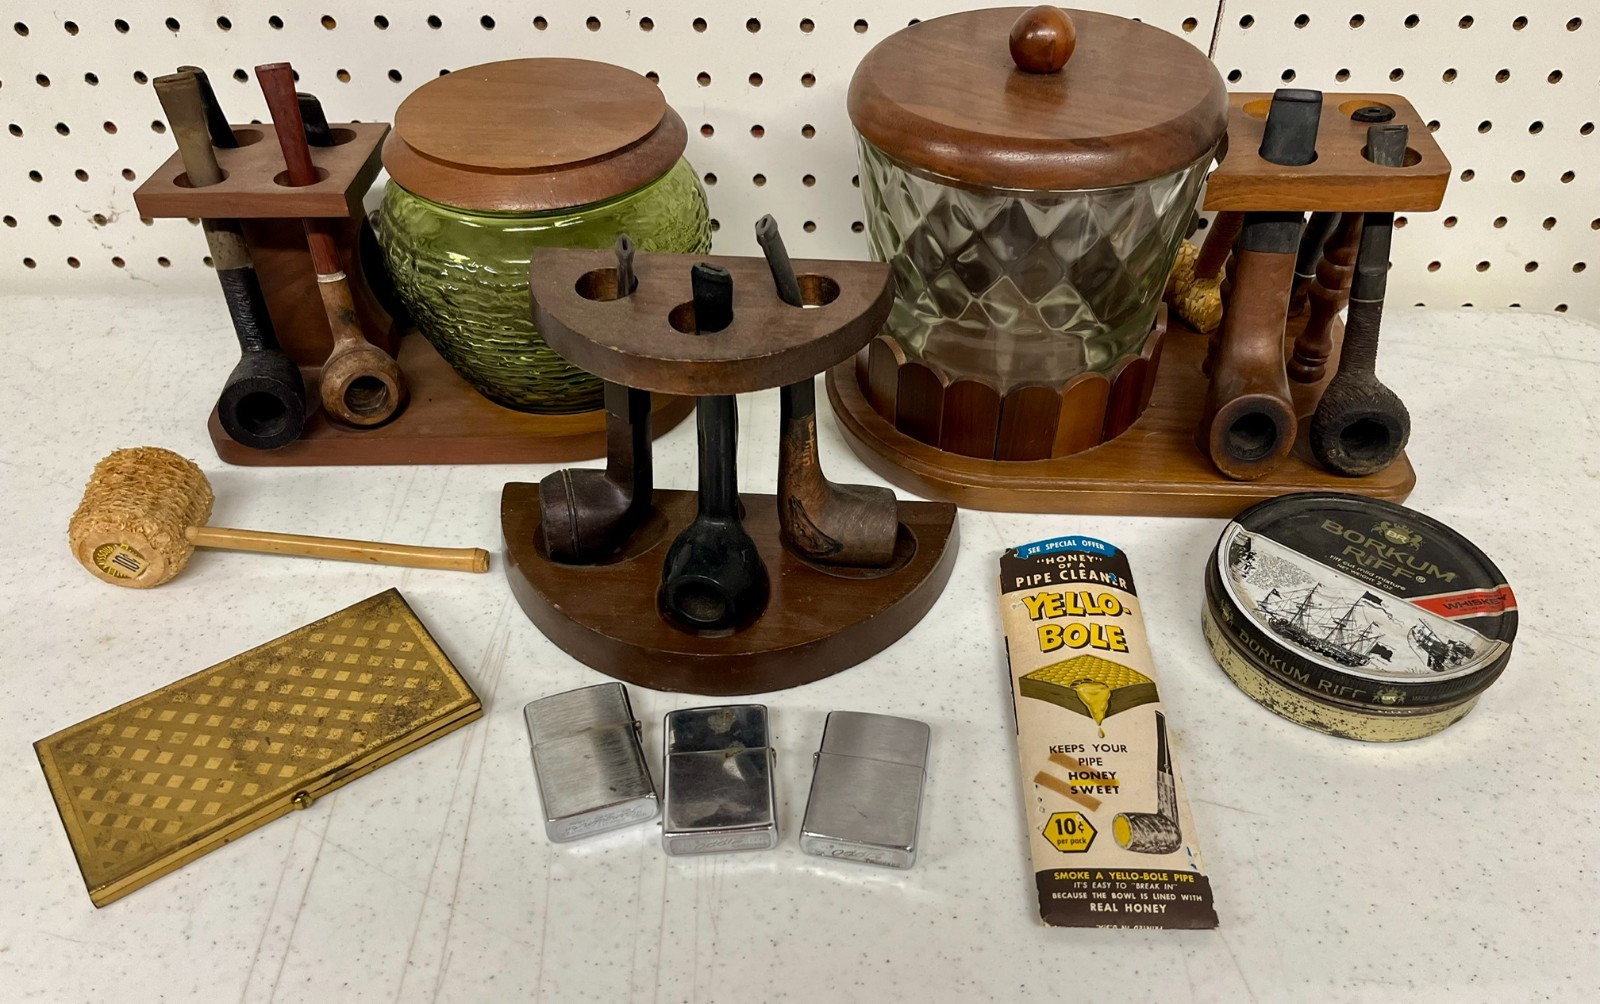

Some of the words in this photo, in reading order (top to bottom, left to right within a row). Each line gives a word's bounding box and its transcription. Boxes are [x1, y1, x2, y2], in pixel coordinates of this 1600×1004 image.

[1385, 529, 1407, 544] BR
[1028, 546, 1041, 555] SEE
[1045, 540, 1077, 551] SPECIAL
[1081, 540, 1105, 551] OFFER
[1320, 519, 1457, 583] BORKUM
[1336, 563, 1350, 572] NET
[1350, 569, 1376, 583] WEIGHT
[1342, 561, 1355, 569] cut
[1357, 566, 1375, 577] mild
[1375, 575, 1407, 591] mixture
[1015, 572, 1052, 588] PIPE
[1443, 594, 1507, 610] WHISKEY
[1037, 622, 1129, 653] BOLE
[1049, 744, 1085, 754] KEEPS
[1092, 744, 1128, 753] YOUR
[1078, 757, 1103, 766] PIPE
[1068, 771, 1117, 780] HONEY
[1070, 785, 1119, 795] SWEET
[1055, 817, 1085, 836] 10¢
[1057, 838, 1068, 846] per
[1070, 837, 1087, 846] pack
[1054, 871, 1090, 880] SMOKE
[1095, 871, 1104, 880] A
[1109, 871, 1169, 881] YELLO-BOLE
[1174, 873, 1195, 883] PIPE
[1074, 881, 1088, 889] IT'S
[1092, 881, 1111, 889] EASY
[1131, 882, 1160, 890] "BREAK
[1111, 892, 1136, 900] BOWL
[1152, 893, 1176, 901] LINED
[1180, 894, 1203, 902] WITH
[1089, 902, 1118, 912] REAL
[1124, 903, 1167, 913] HONEY
